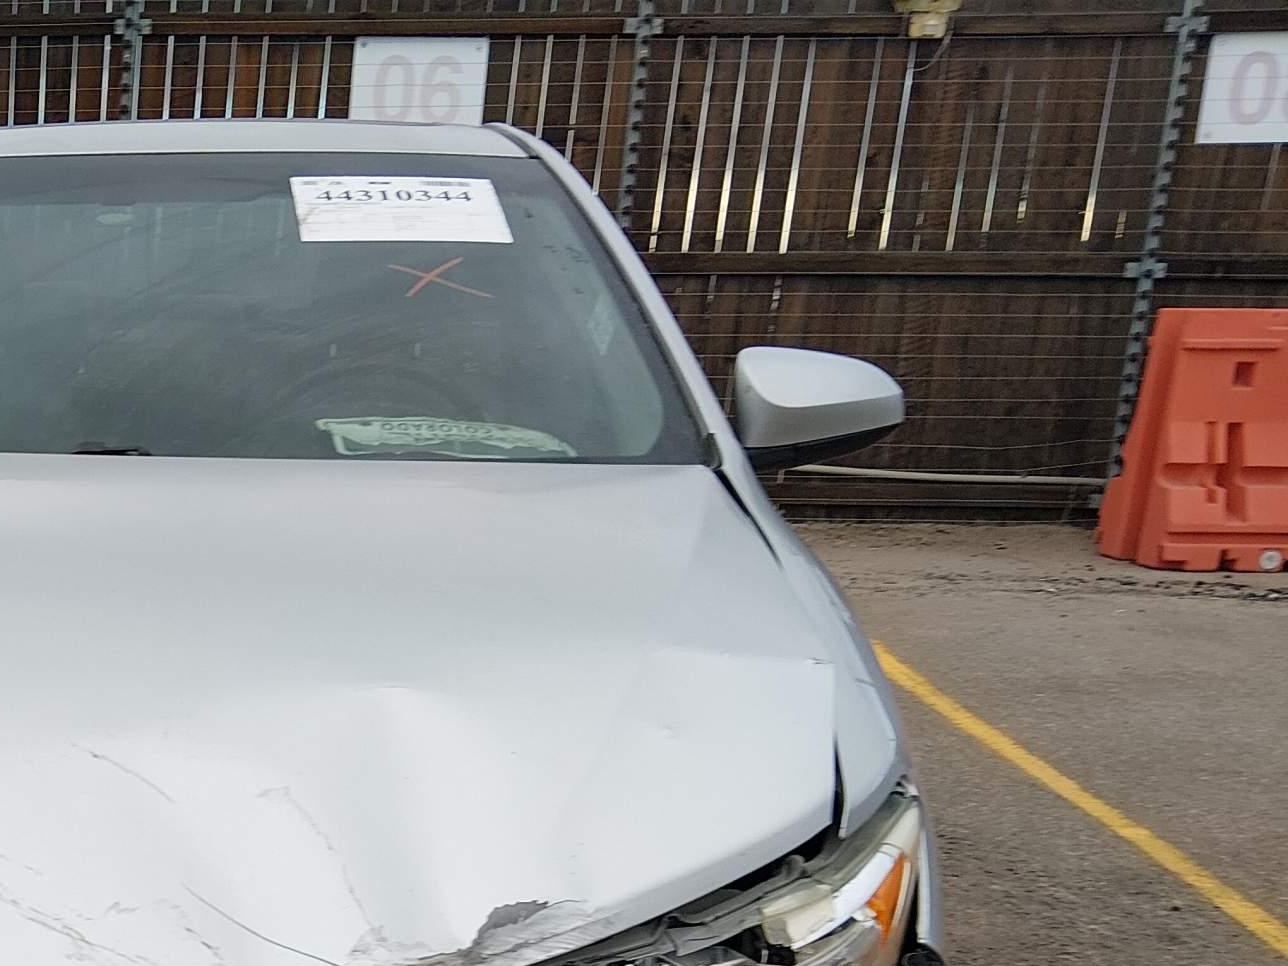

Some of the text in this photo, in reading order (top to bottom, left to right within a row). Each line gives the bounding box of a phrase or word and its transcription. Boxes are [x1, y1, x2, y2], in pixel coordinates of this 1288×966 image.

[373, 54, 465, 122] 06
[1228, 50, 1288, 126] 0
[315, 189, 473, 203] 44310344
